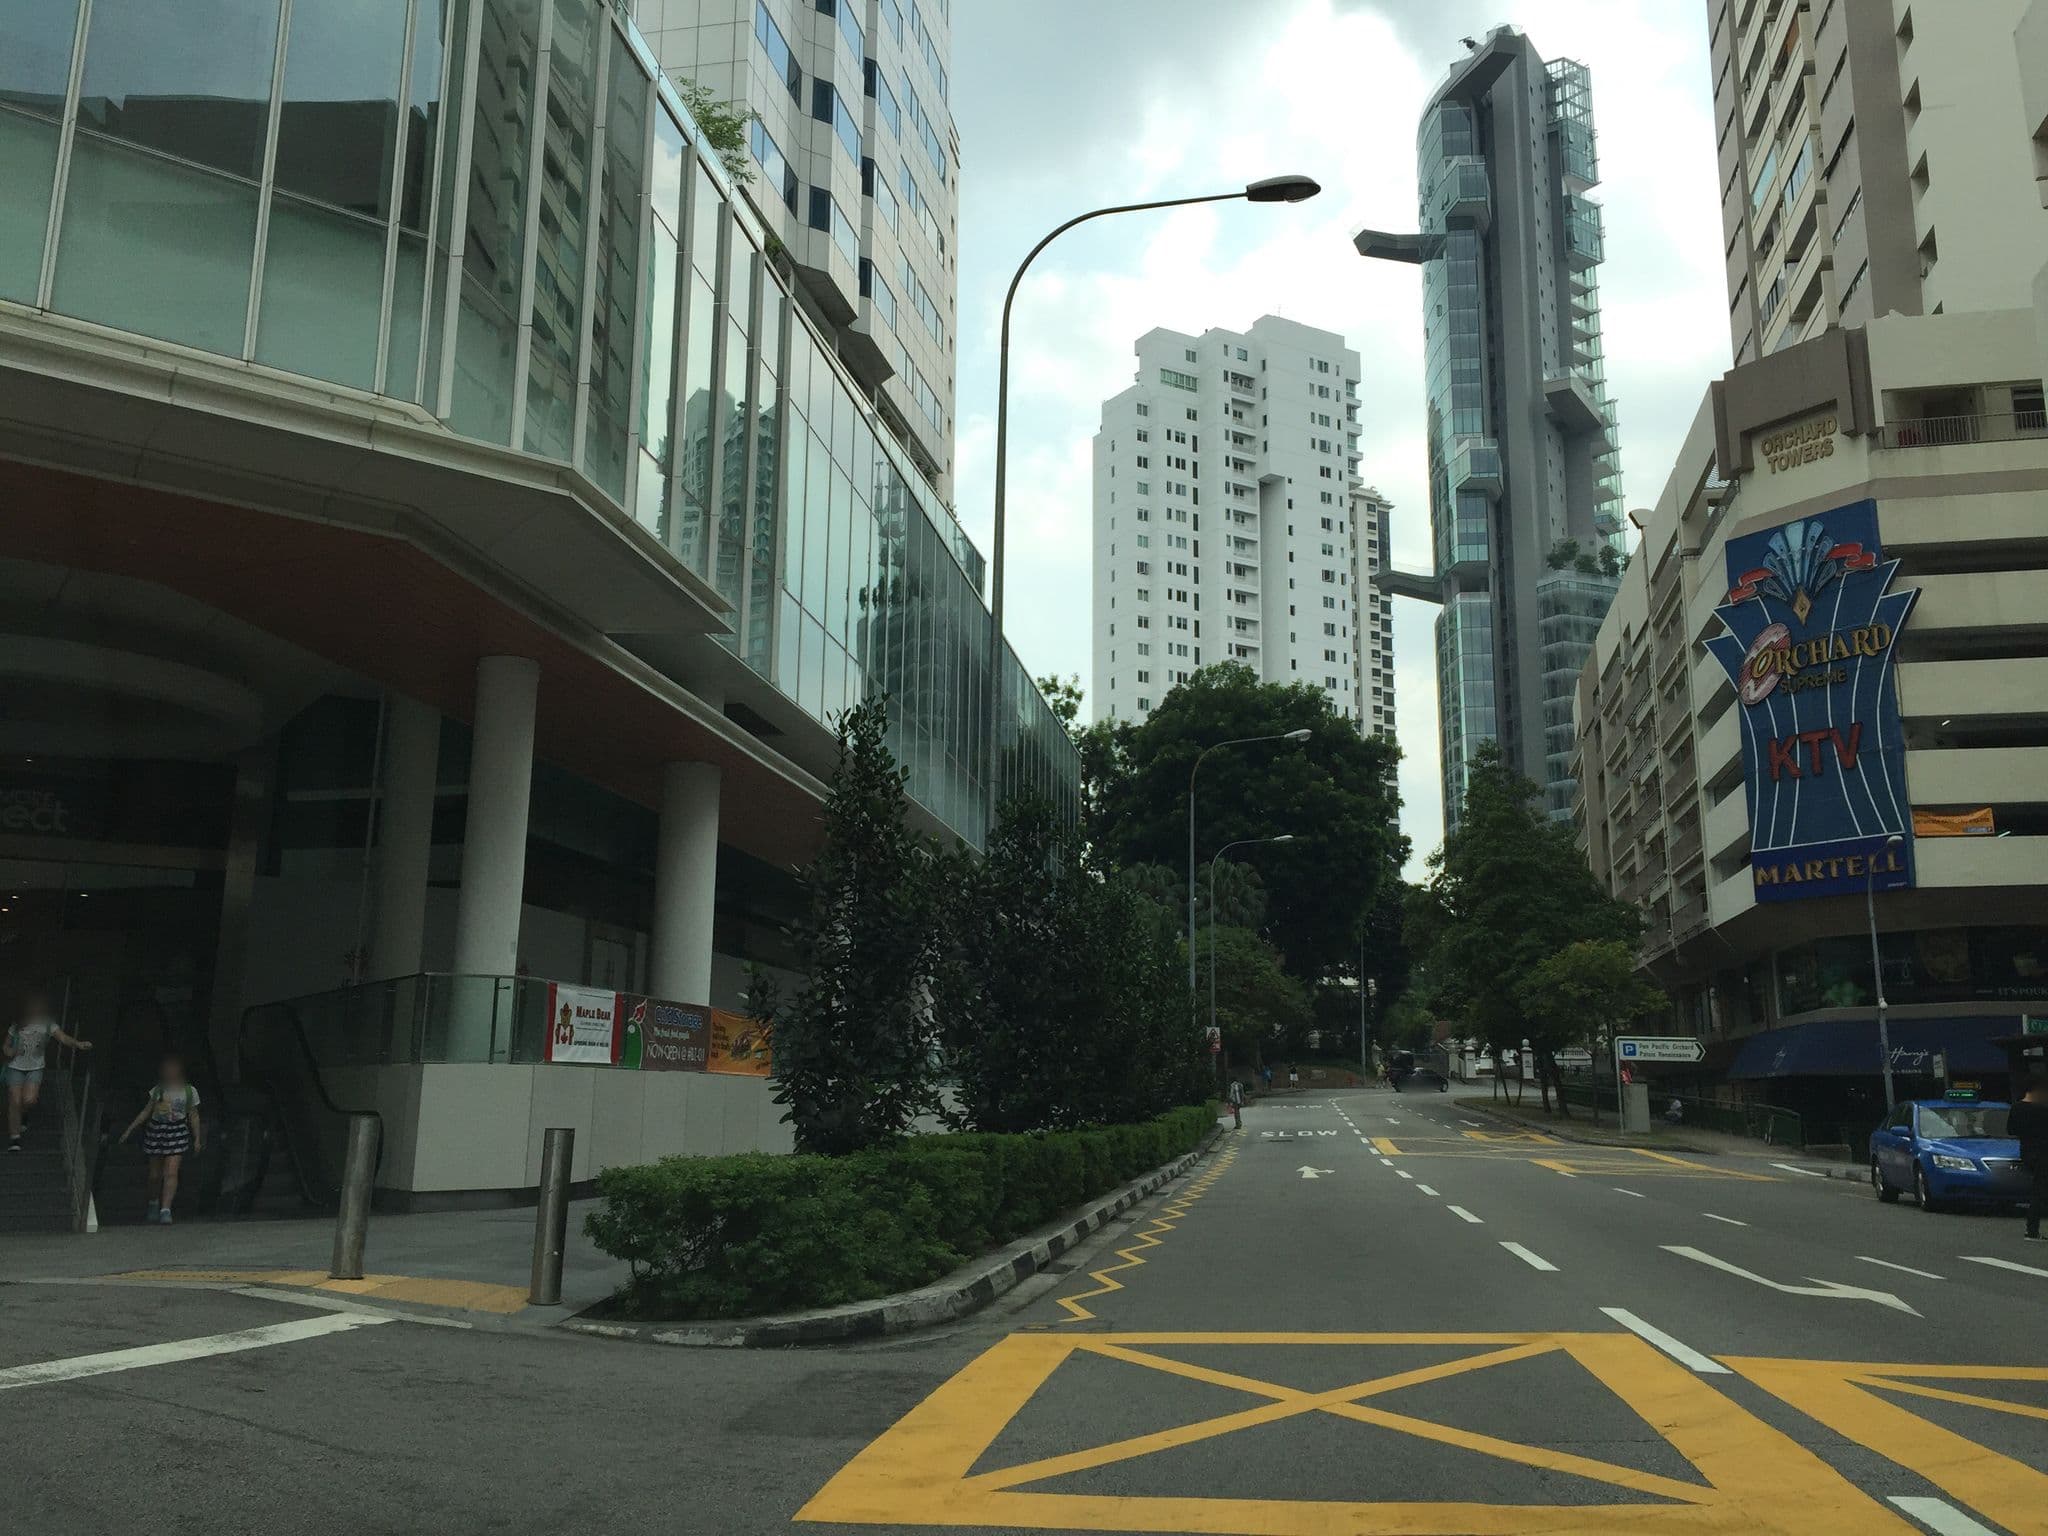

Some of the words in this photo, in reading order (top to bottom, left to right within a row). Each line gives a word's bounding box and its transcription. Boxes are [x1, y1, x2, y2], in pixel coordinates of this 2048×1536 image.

[1761, 415, 1837, 456] ORCHARD
[1768, 438, 1834, 474] TOWERS
[1751, 622, 1893, 679] ORCHARD
[1780, 668, 1848, 694] SUPREME
[1768, 721, 1863, 782] KTV
[1755, 850, 1905, 887] MARTELL
